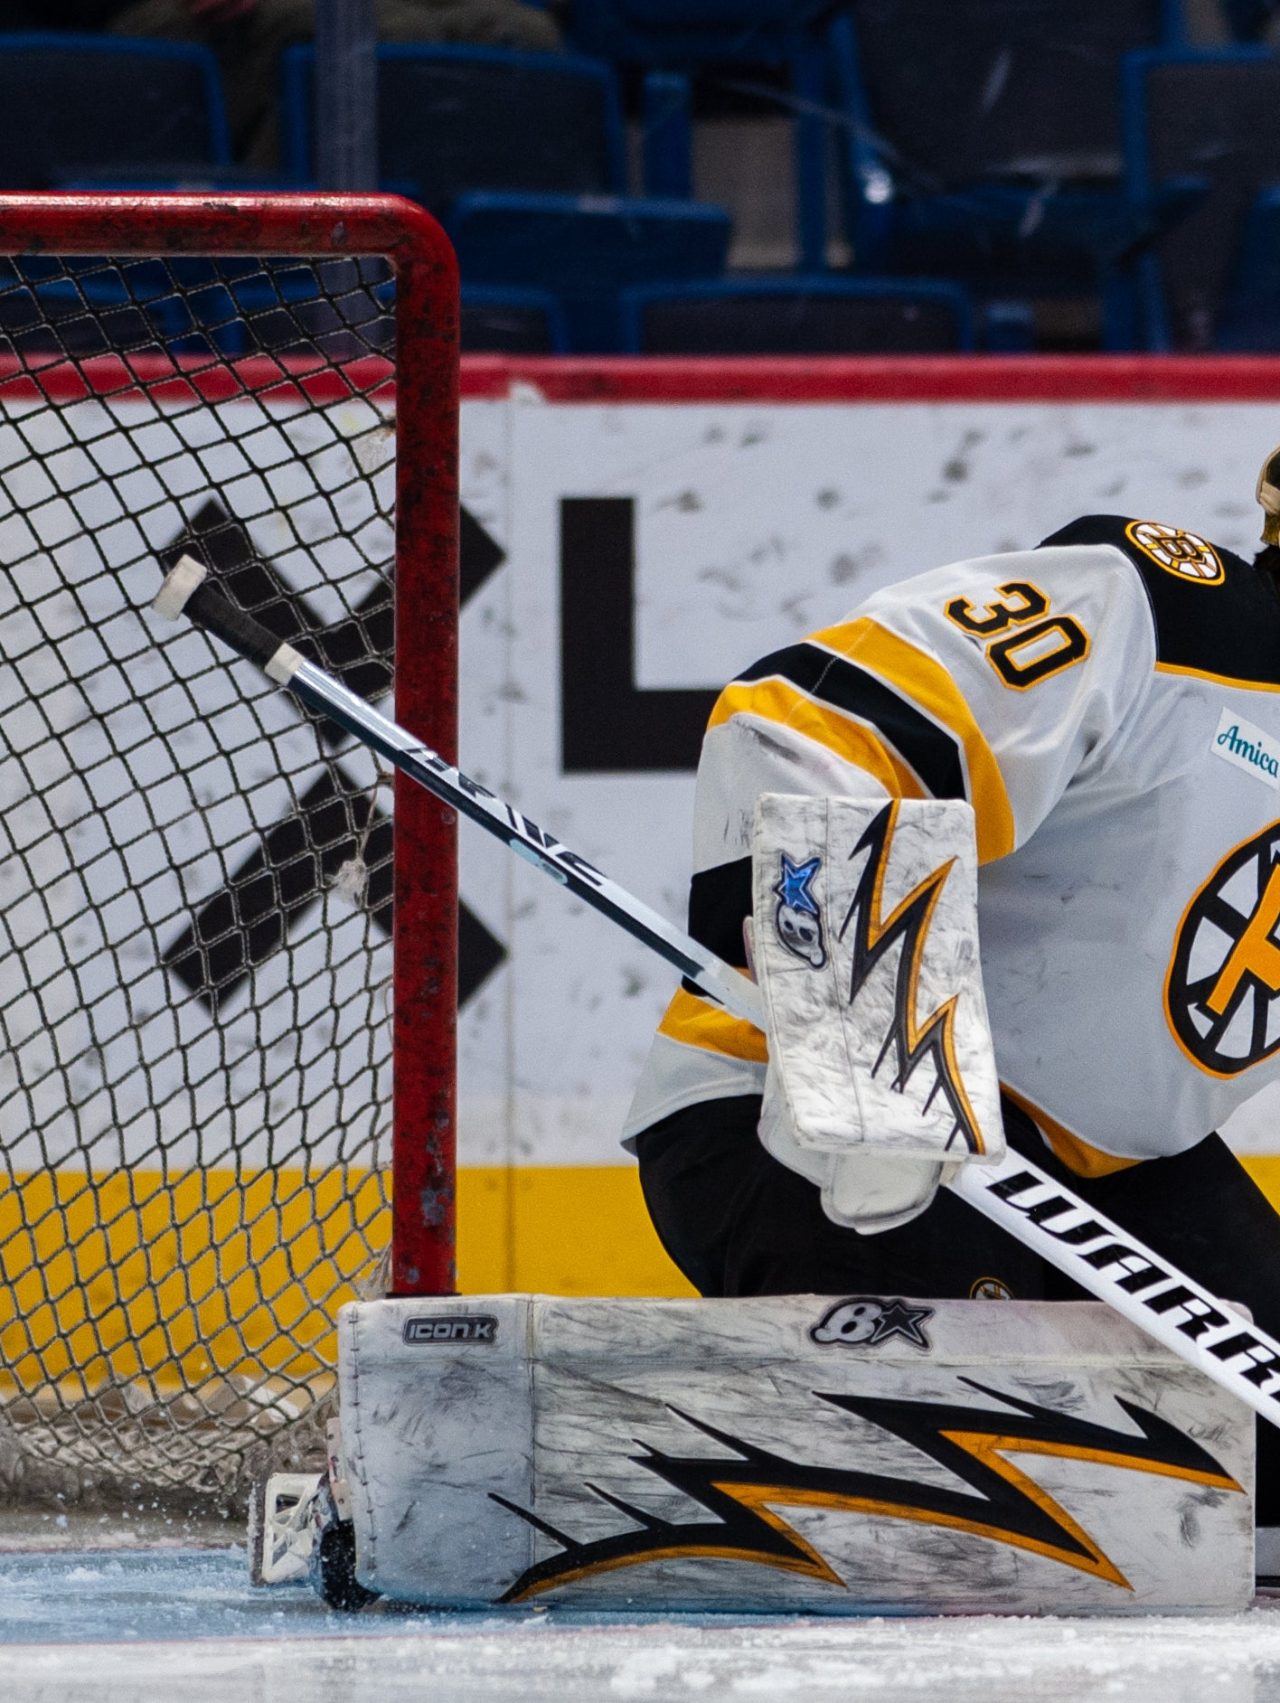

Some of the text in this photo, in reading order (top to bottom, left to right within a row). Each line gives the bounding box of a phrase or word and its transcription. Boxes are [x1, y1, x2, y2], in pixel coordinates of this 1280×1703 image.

[944, 580, 1091, 692] 30
[1216, 724, 1280, 779] Amica
[474, 1323, 493, 1339] K
